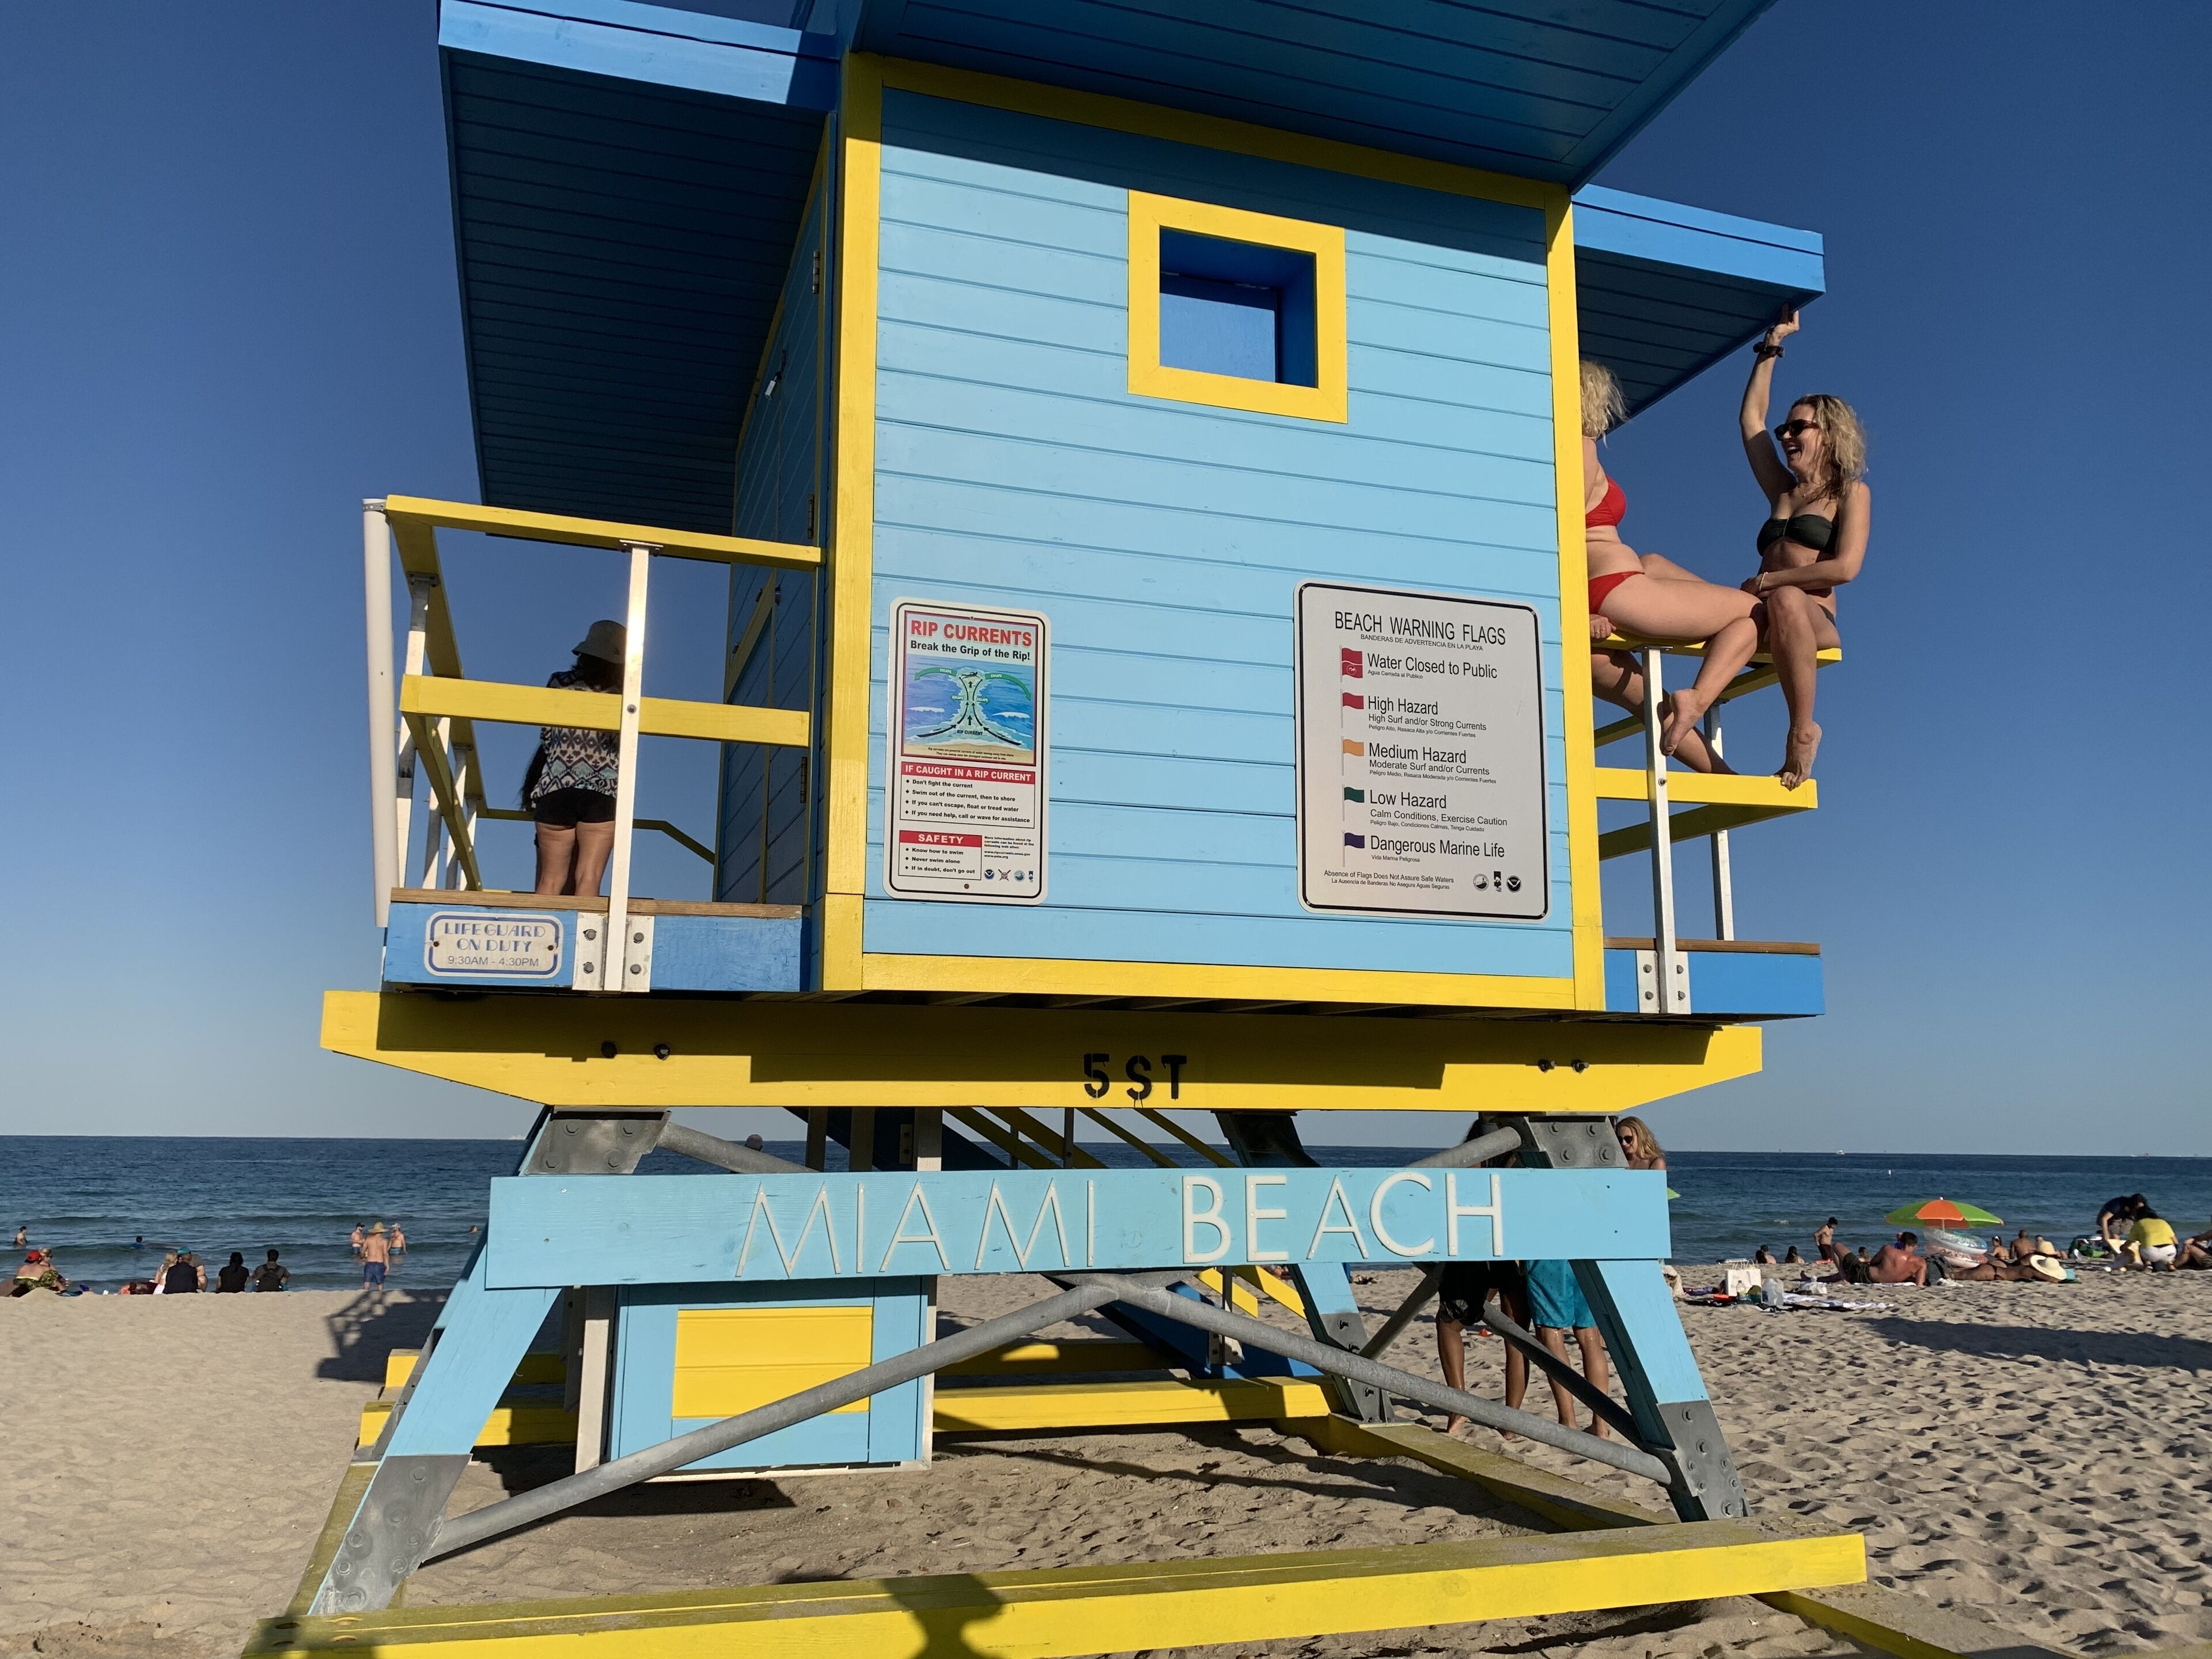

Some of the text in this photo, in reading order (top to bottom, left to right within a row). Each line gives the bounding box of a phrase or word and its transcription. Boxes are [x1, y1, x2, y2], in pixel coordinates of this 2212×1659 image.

[911, 620, 1032, 647] RIP CURRENTS
[1335, 611, 1506, 645] BEACH WARNING FLAGS
[1361, 634, 1393, 642] BANDERAS
[1404, 639, 1446, 647] ADVERTENCIA
[911, 641, 1030, 662] Break the Grip of the Rip!
[1368, 653, 1498, 678] Water Closed to Public
[1369, 696, 1438, 715] High Hazard
[1369, 714, 1385, 724] High
[1388, 715, 1403, 724] Surf
[1430, 718, 1454, 730] Strong
[1456, 721, 1487, 730] Currents
[1369, 743, 1466, 763] Medium Hazard
[906, 764, 914, 772] IF
[916, 766, 952, 775] CAUGHT
[955, 768, 964, 777] IN
[991, 771, 1031, 781] CURRENT
[1370, 760, 1490, 775] Moderate Surf and/or Currents
[1370, 790, 1446, 809] Low Hazard
[1370, 809, 1508, 825] Calm Conditions, Exercise Caution
[918, 834, 964, 844] SAFETY
[1371, 835, 1505, 858] Dangerous Marine Life
[1357, 872, 1373, 880] Flags
[445, 923, 546, 937] LIFEGUARD
[457, 938, 532, 952] ON DUTY
[448, 956, 488, 965] 9:30AM
[498, 958, 539, 967] 4:30PM
[736, 1172, 1504, 1279] MIAMI BEACH
